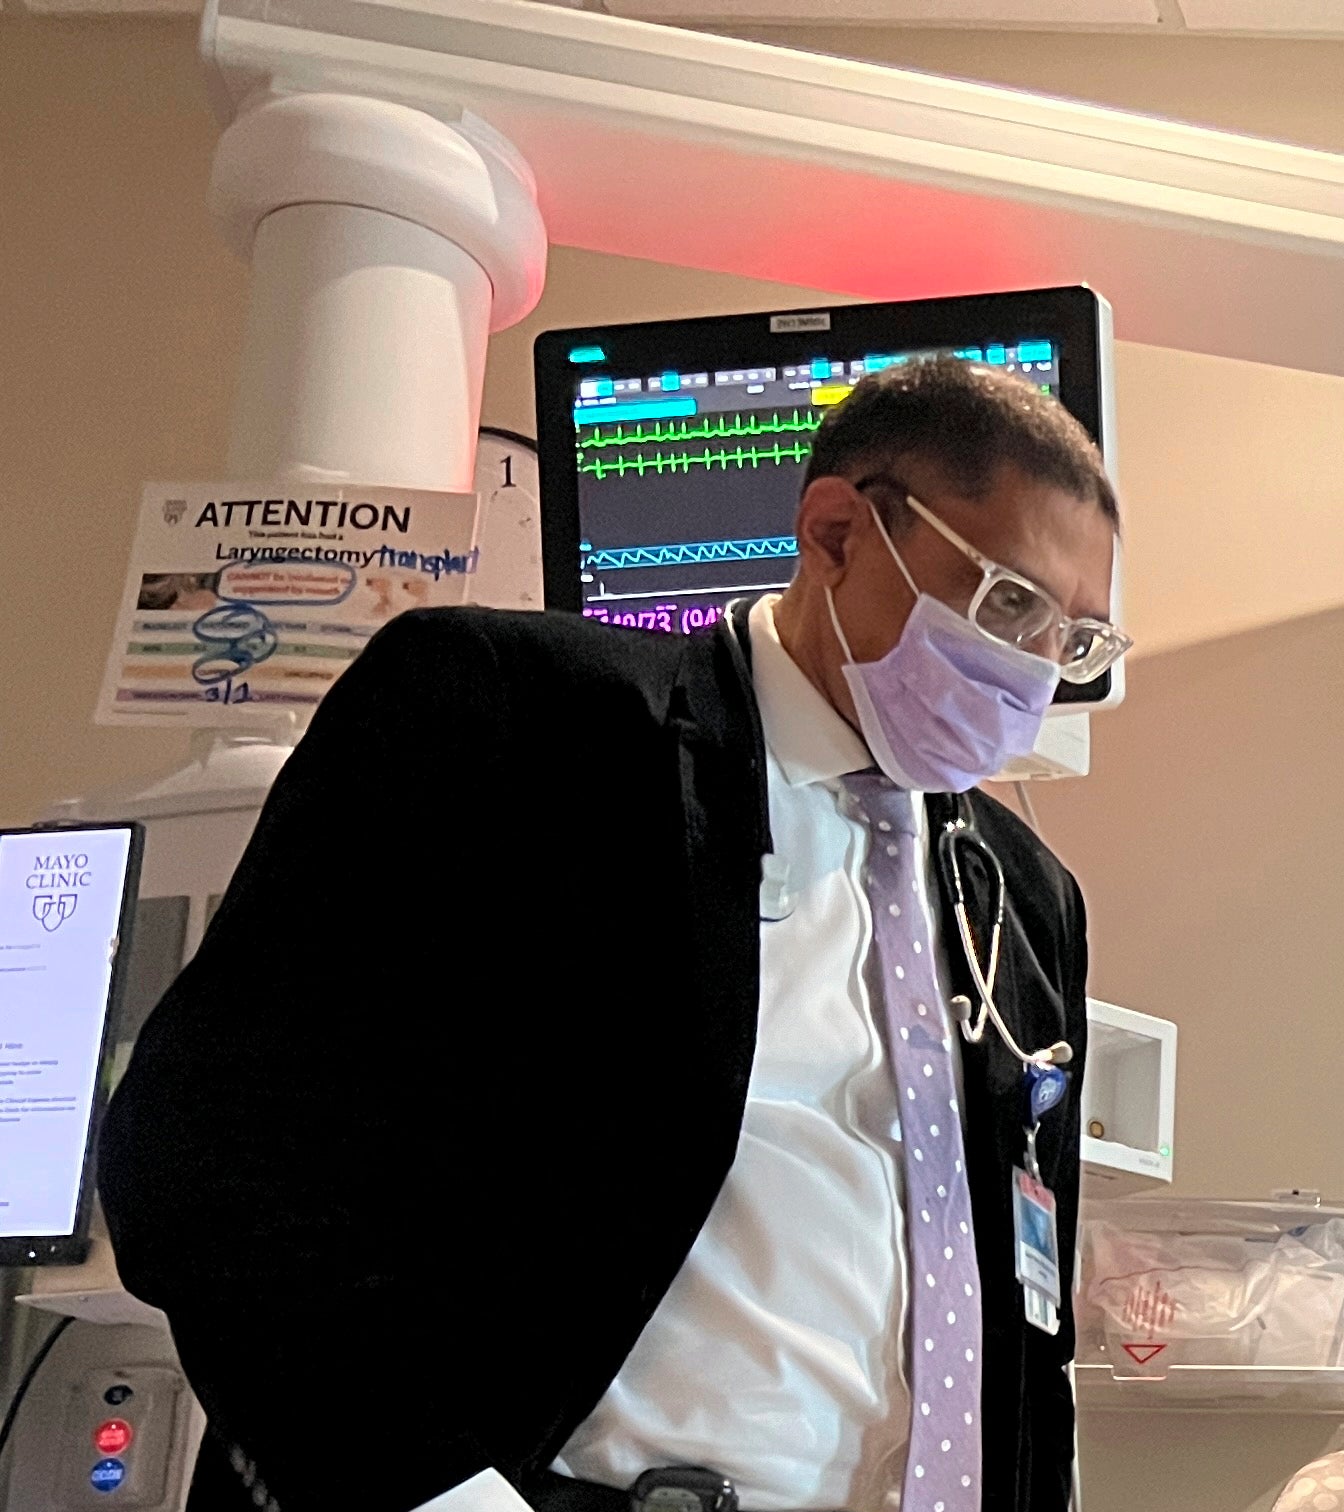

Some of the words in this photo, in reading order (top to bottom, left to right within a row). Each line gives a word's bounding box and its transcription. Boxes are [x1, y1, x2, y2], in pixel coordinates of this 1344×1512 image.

[500, 455, 517, 488] 1
[195, 500, 411, 533] ATTENTION
[215, 543, 378, 569] Laryngectomy
[34, 853, 89, 871] MAYO
[25, 871, 92, 889] CLINIC
